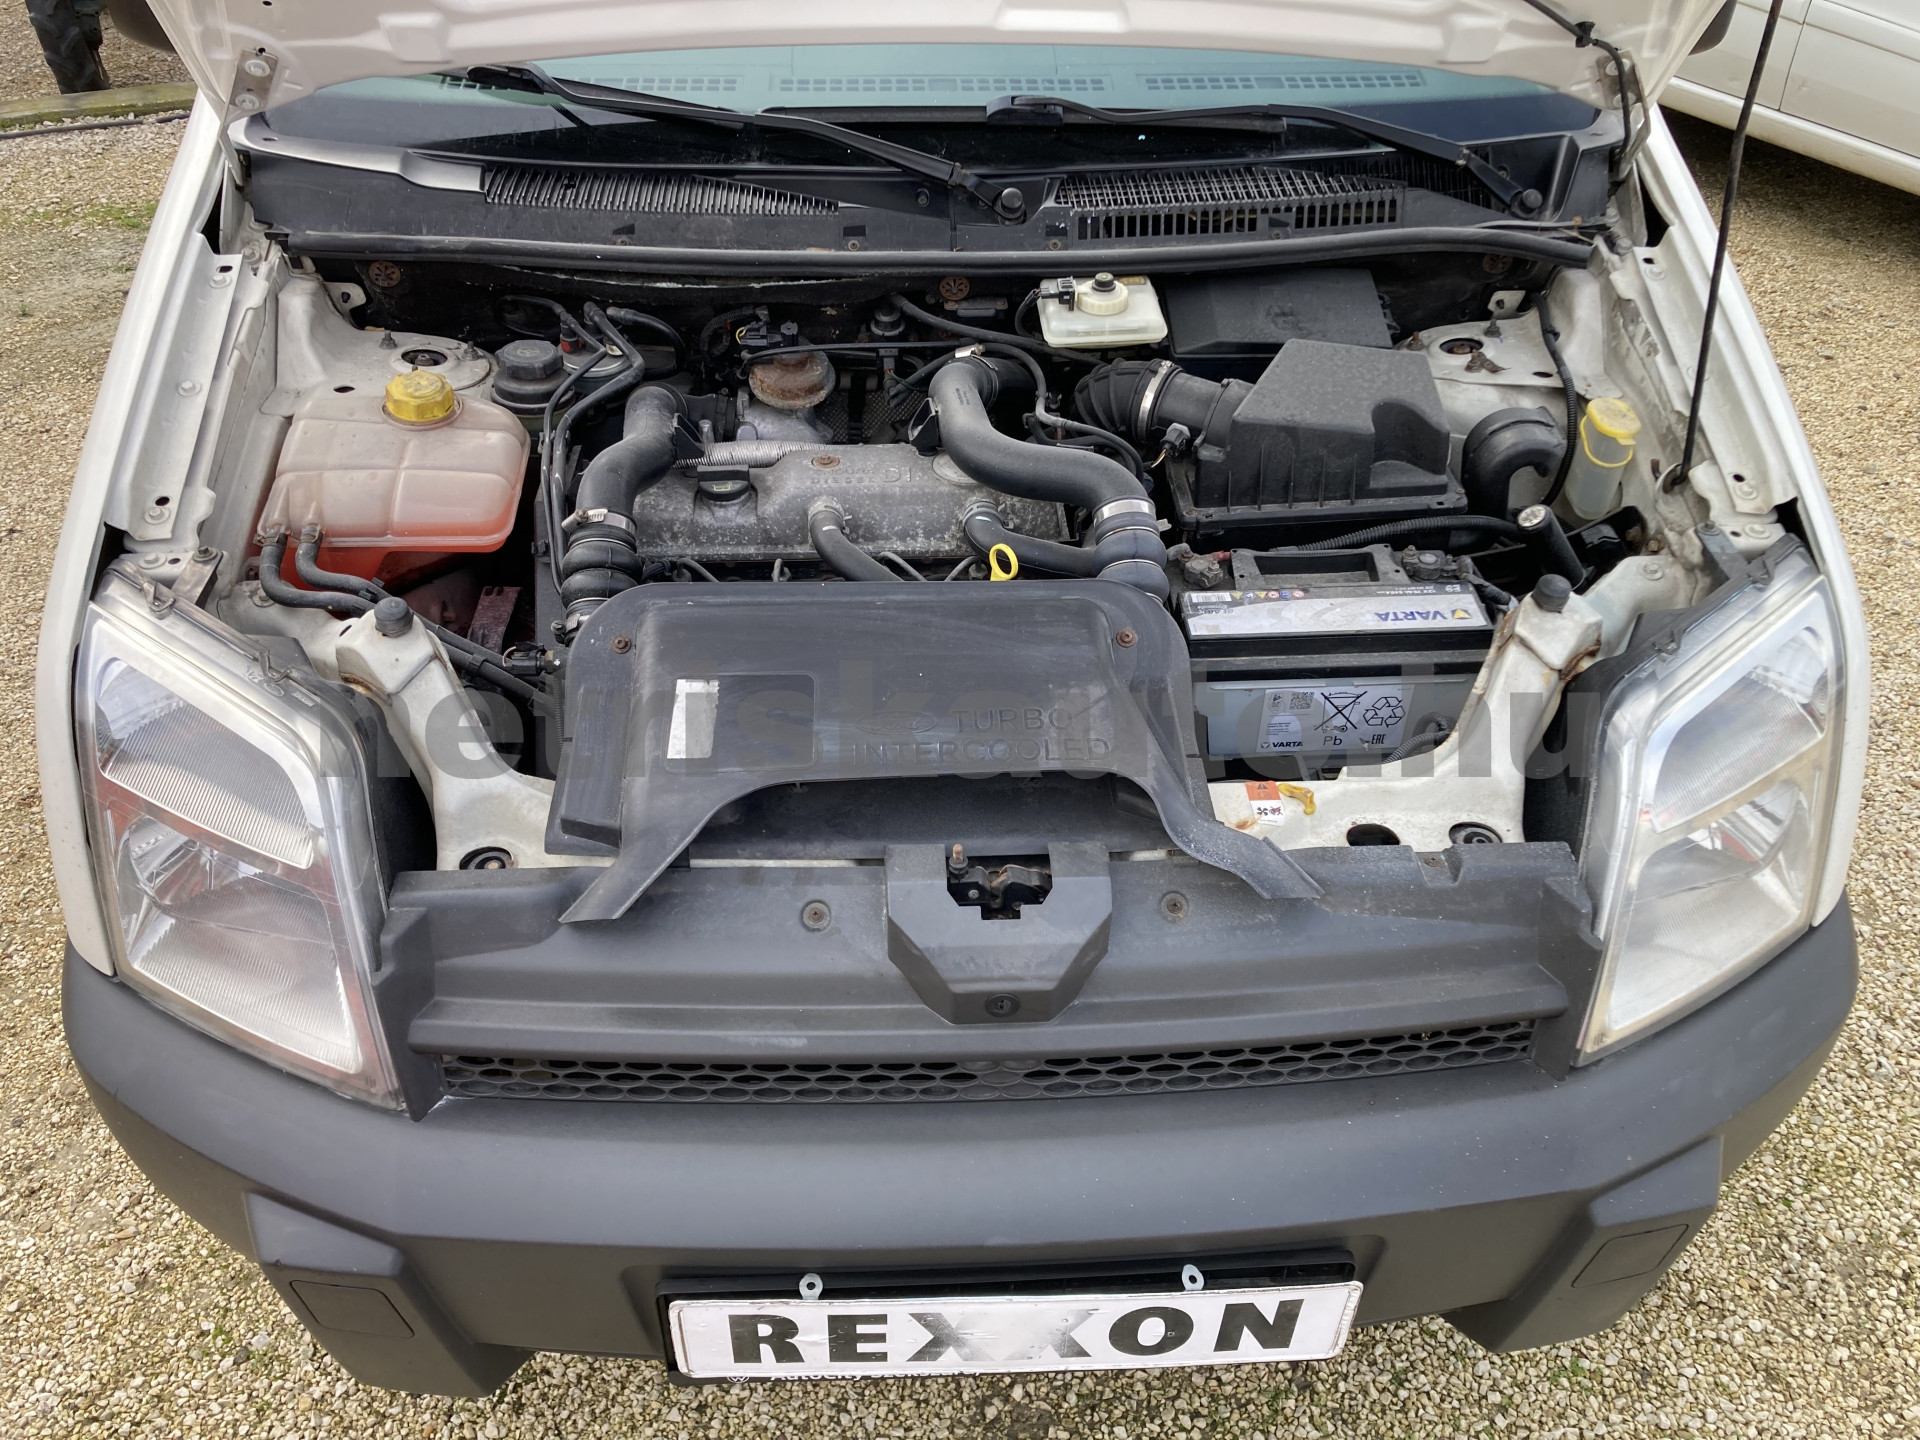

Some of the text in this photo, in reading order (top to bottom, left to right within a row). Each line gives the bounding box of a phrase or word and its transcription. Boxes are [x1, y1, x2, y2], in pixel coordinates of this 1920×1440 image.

[1374, 610, 1448, 622] VARTA
[950, 706, 1074, 733] TURBO
[852, 737, 1110, 766] INTERCOOLED
[1323, 735, 1343, 746] Pb
[727, 1297, 1305, 1365] REXXON
